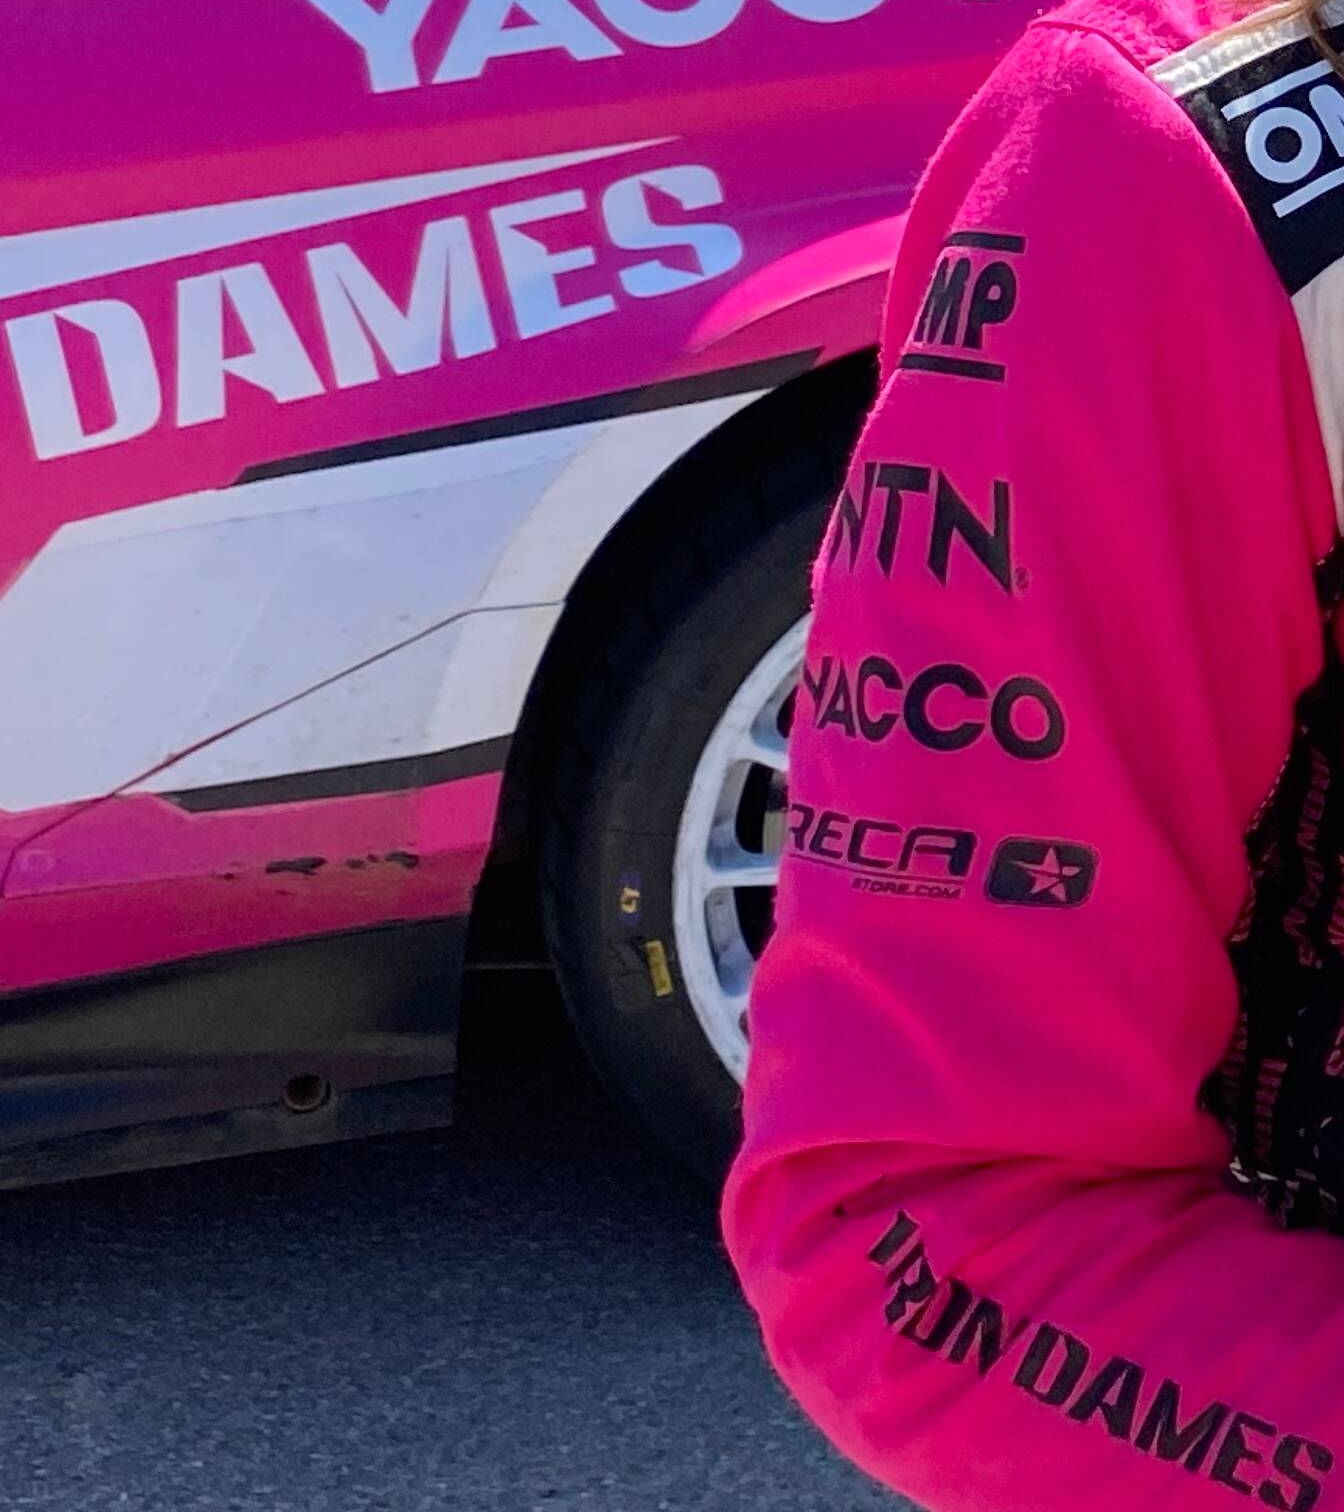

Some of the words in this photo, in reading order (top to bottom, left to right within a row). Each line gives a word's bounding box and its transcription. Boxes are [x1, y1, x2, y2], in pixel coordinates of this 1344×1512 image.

[5, 164, 744, 461] DAMES
[913, 256, 1017, 349] MP
[829, 462, 1014, 596] NTN
[803, 655, 1066, 760] YACCO
[790, 803, 977, 877] RECA
[868, 1208, 1029, 1376] IRON
[1013, 1320, 1336, 1512] DAMES
